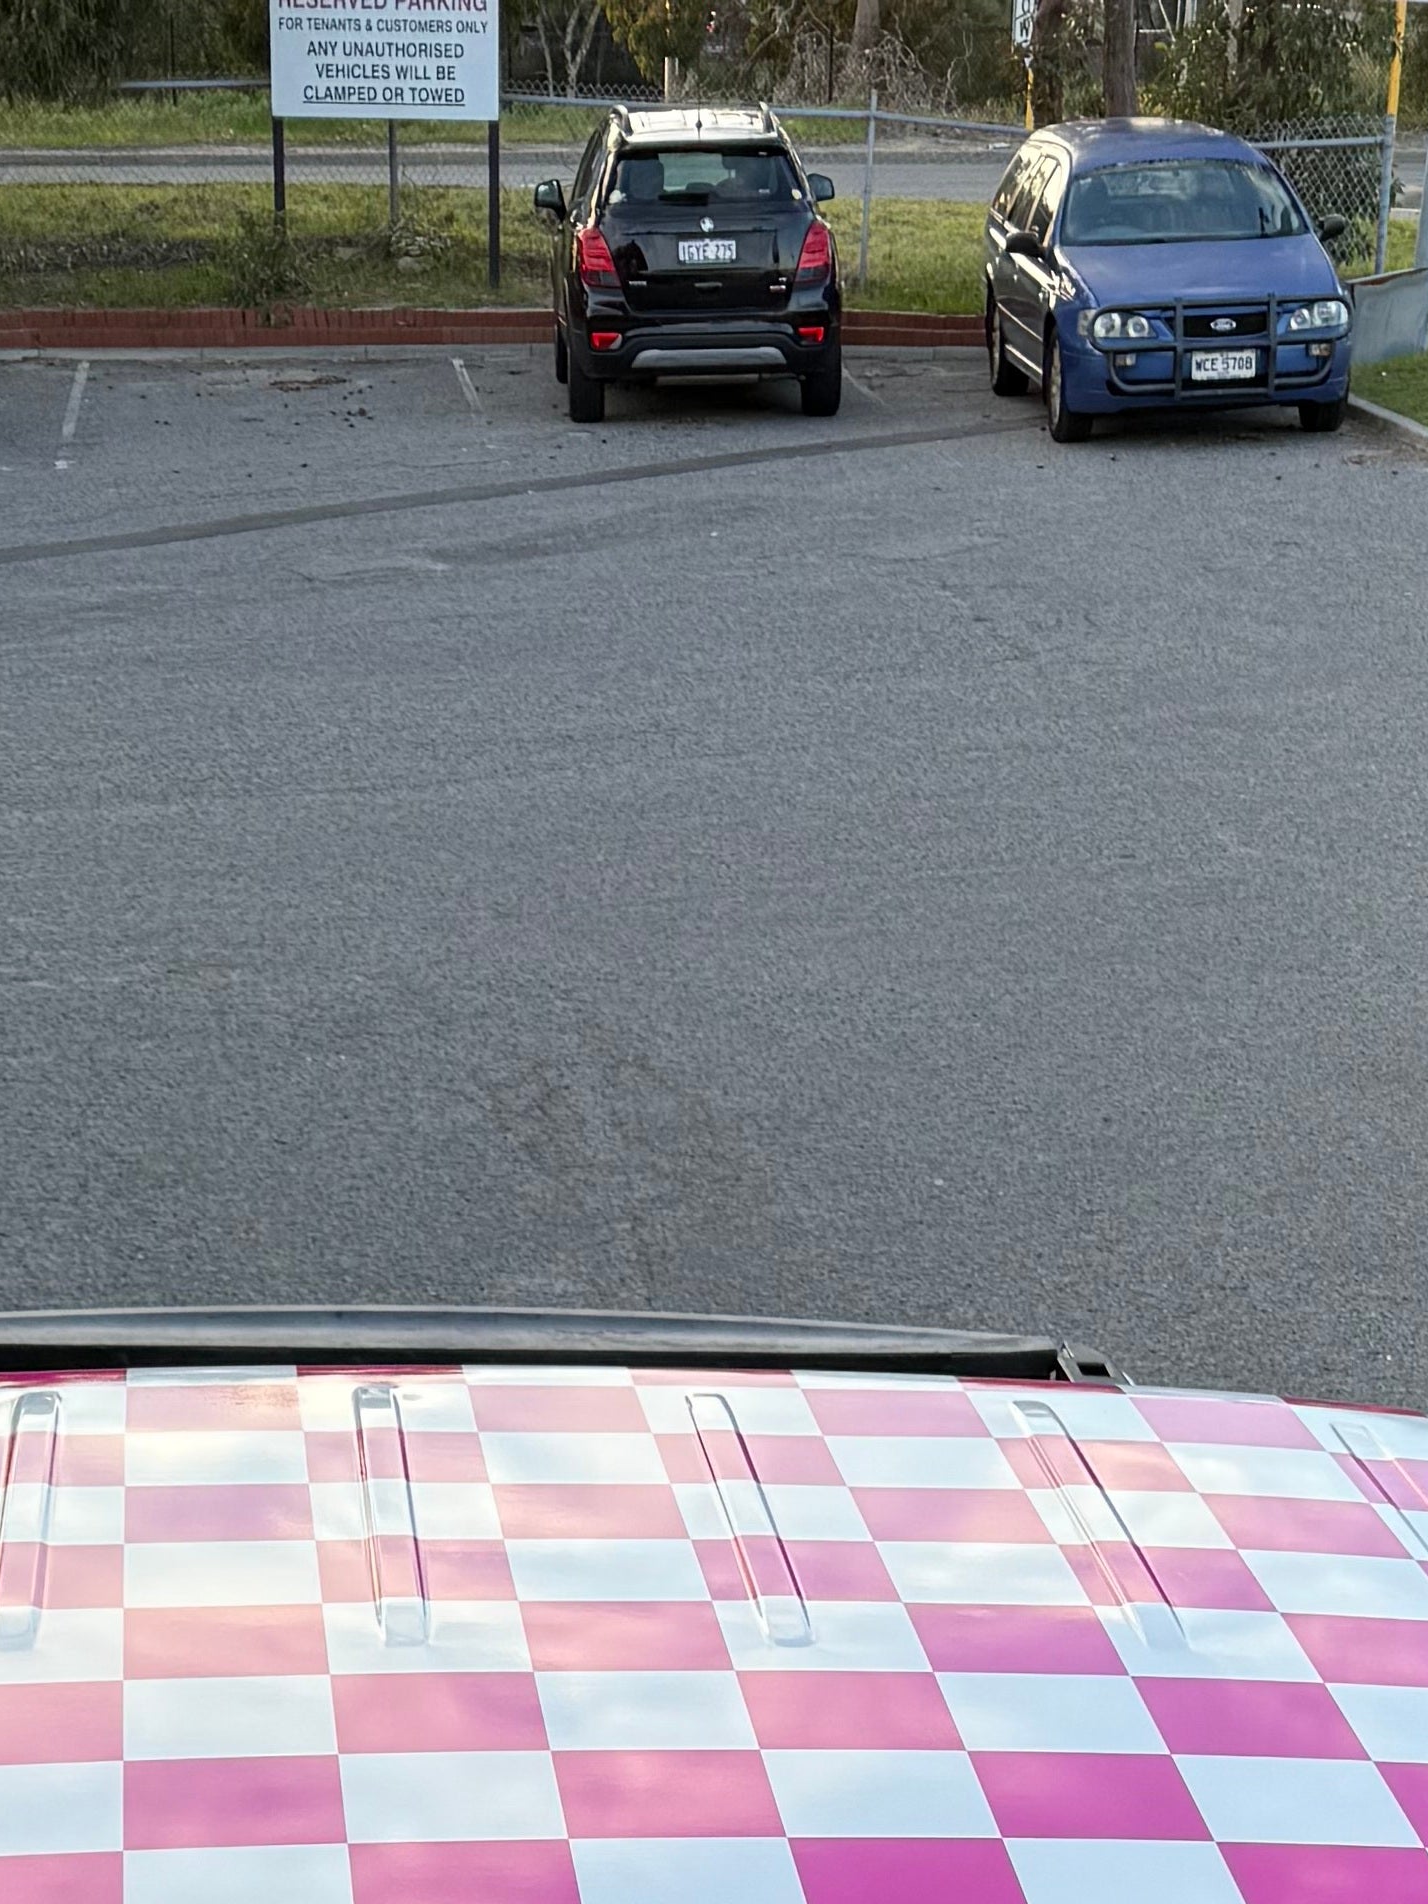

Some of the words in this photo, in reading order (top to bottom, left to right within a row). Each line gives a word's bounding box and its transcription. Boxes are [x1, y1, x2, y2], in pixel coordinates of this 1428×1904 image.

[278, 17, 303, 30] FOR
[307, 18, 361, 31] TENANTS
[365, 19, 372, 32] &
[376, 19, 452, 33] CUSTOMERS
[456, 20, 488, 34] ONLY
[307, 41, 338, 57] ANY
[342, 41, 464, 58] UNAUTHORISED
[316, 64, 390, 80] VEHICLES
[395, 65, 431, 80] WILL
[436, 66, 456, 80] BE
[303, 85, 377, 102] CLAMPED
[382, 87, 404, 102] OR
[408, 87, 465, 103] TOWED
